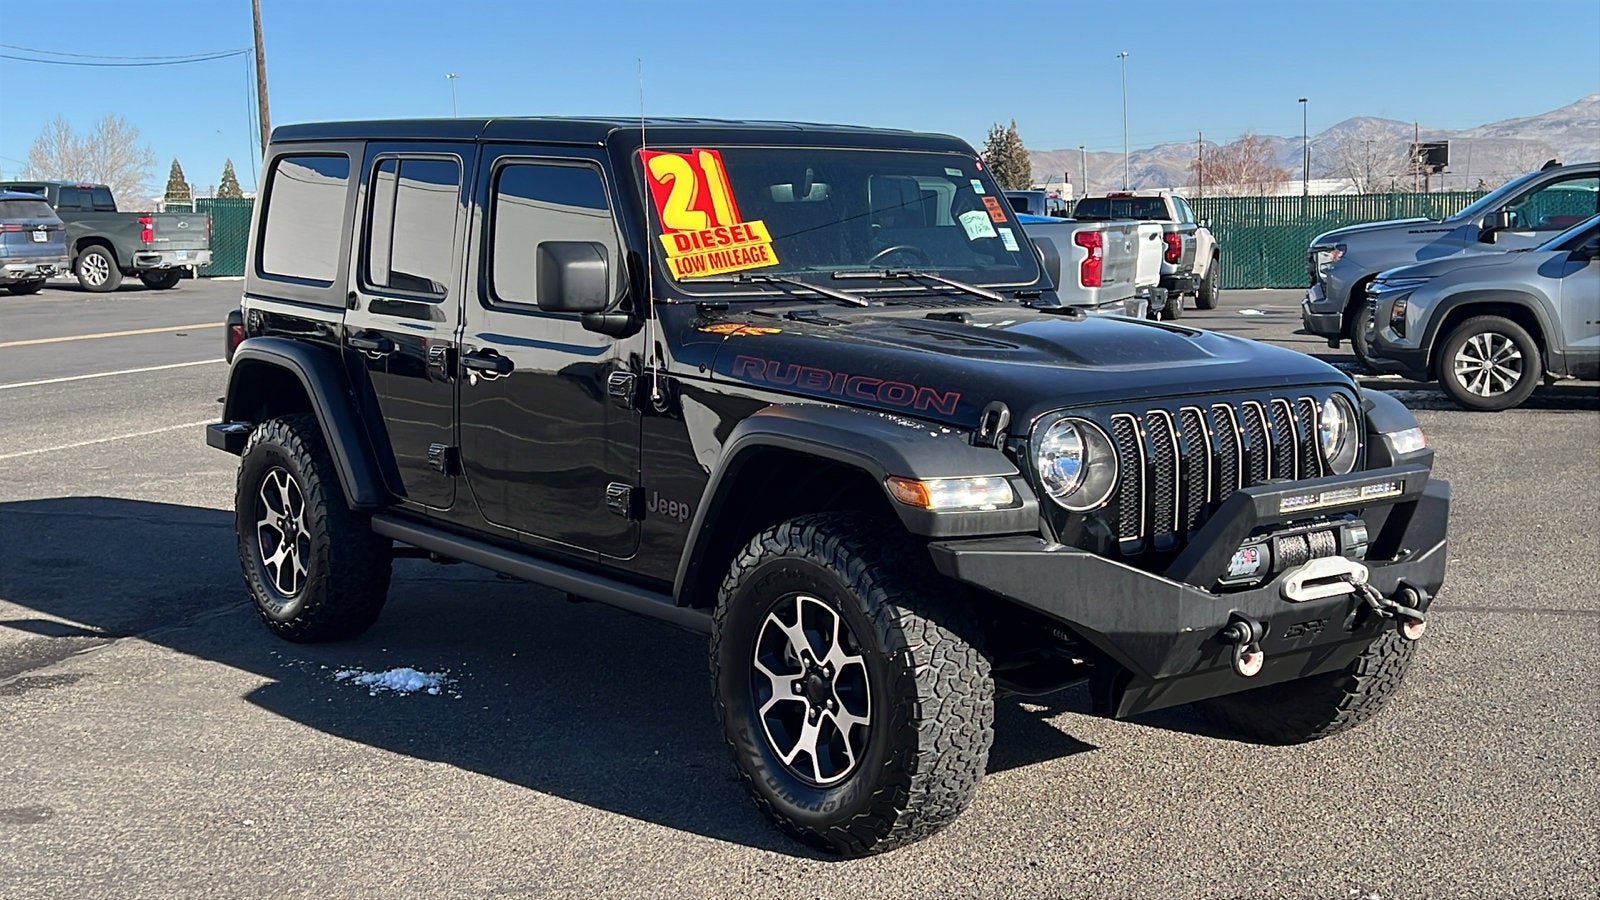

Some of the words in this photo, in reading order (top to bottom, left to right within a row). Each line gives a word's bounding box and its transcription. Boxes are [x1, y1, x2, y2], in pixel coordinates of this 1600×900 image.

[648, 150, 738, 231] 21
[673, 224, 760, 253] DIESEL
[674, 255, 706, 275] LOW
[707, 245, 769, 270] MILEAGE
[731, 354, 961, 416] RUBICON
[647, 491, 690, 523] Jeep
